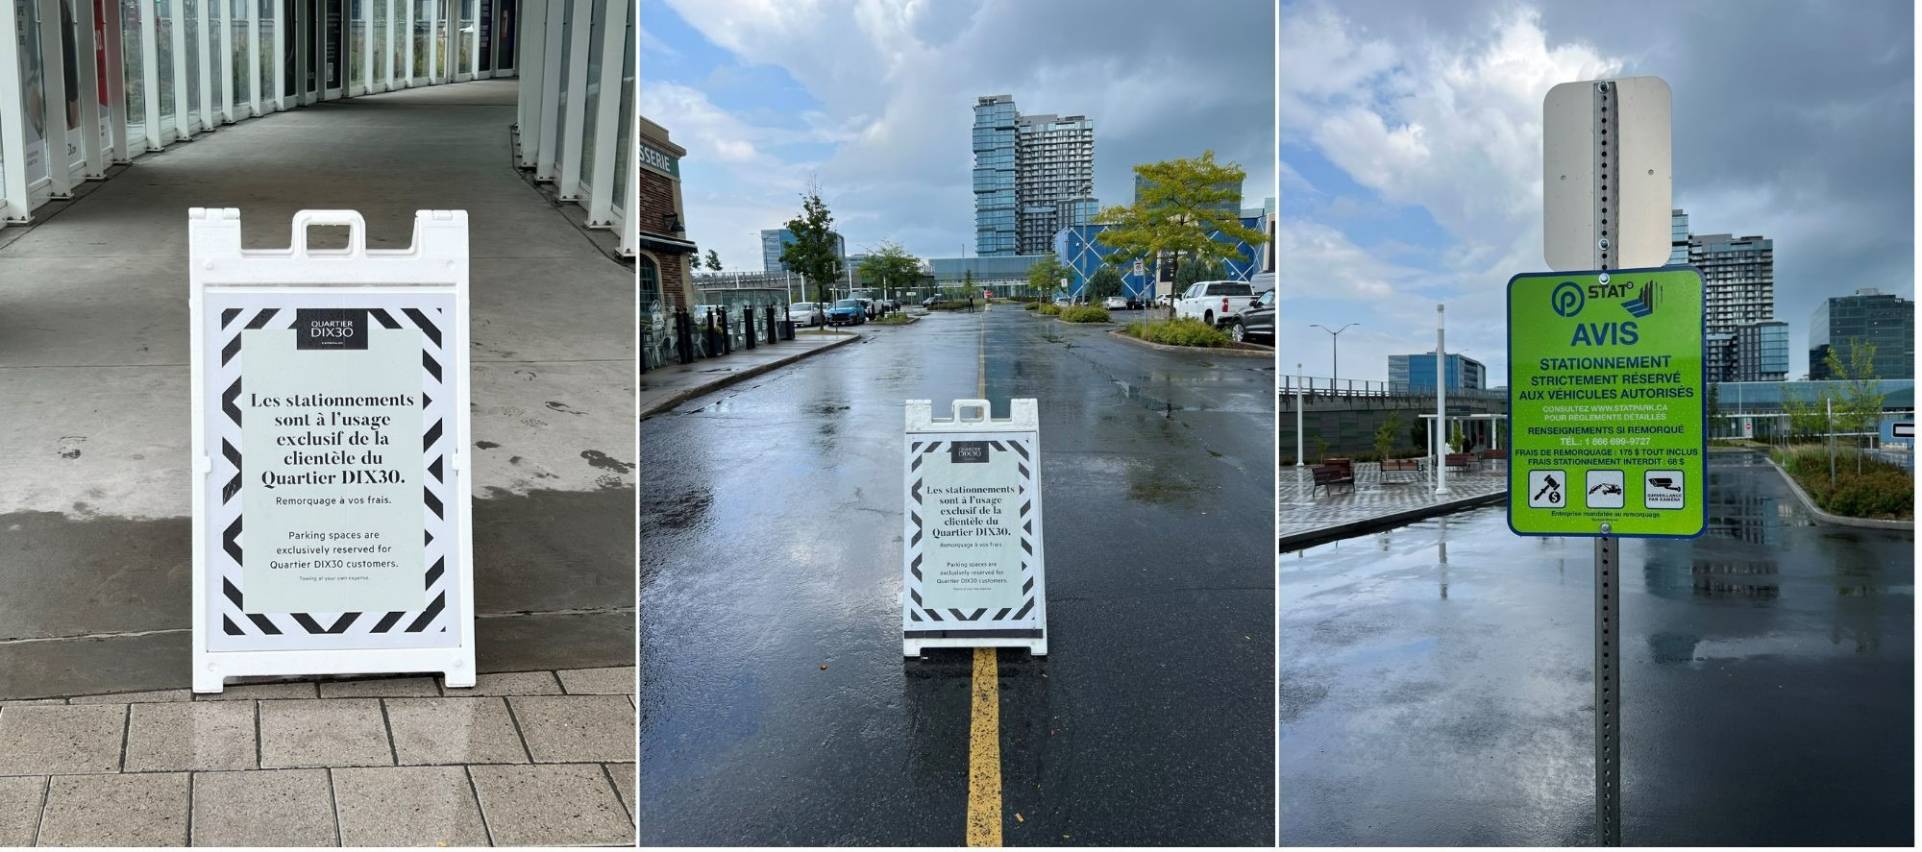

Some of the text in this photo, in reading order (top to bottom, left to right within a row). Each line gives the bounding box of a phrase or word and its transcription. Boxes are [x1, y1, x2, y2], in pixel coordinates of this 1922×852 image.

[311, 320, 353, 328] QUARTIER
[1570, 321, 1639, 346] AVIS
[1539, 355, 1671, 371] STATIONNEMENT
[1531, 372, 1681, 386] STRICTEMENT RÉSERVÉ
[1519, 385, 1694, 400] AUX VÉHICULES AUTORISÉS
[251, 393, 414, 407] Les stationnements
[275, 414, 310, 426] sont
[316, 412, 325, 426] à
[1528, 426, 1614, 434] RENSEIGNEMENTS
[276, 430, 389, 446] exclusif de la
[1585, 438, 1590, 446] 1
[283, 450, 383, 465] clientèle du
[261, 470, 406, 489] Quartier DIX30.
[927, 486, 1015, 495] Les stationnements
[275, 496, 336, 507] Remorquage
[339, 496, 345, 504] à
[367, 495, 392, 505] frais.
[940, 497, 959, 505] sont
[962, 497, 967, 505] à
[940, 506, 1002, 516] exclusif de la
[944, 517, 999, 527] clientèle du
[288, 531, 380, 541] Parking spaces are
[932, 527, 1012, 540] Quartier DIX30.
[276, 543, 392, 555] exclusively reserved for
[269, 559, 399, 570] Quartier DIX30 customers.
